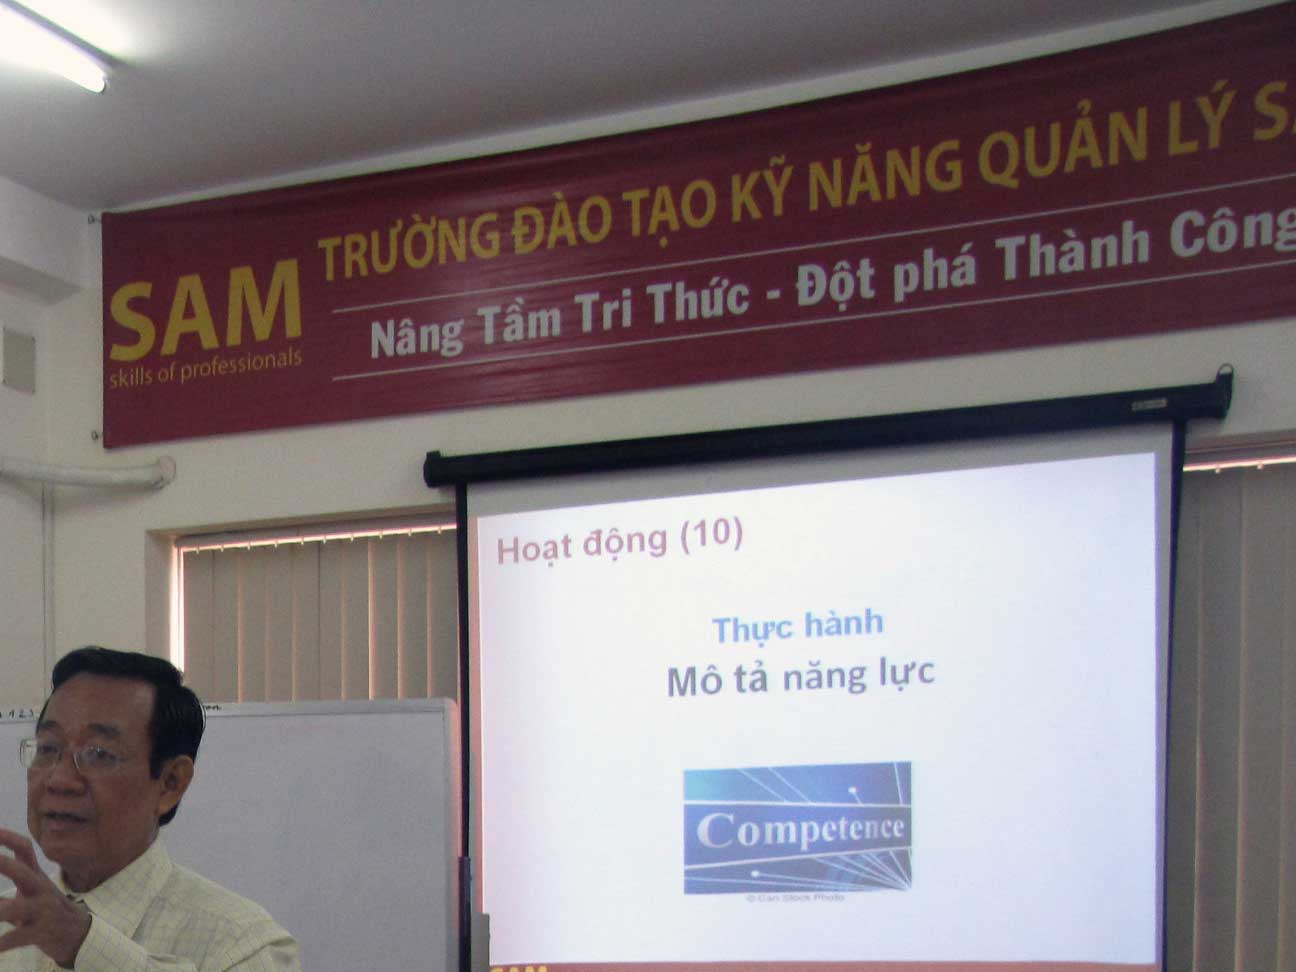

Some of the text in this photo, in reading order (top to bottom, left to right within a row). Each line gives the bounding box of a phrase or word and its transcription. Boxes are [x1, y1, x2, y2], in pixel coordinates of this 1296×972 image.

[318, 79, 1296, 281] TRƯỜNG ĐÀO TẠO KỸ NĂNG QUẢN LÝ S
[371, 318, 463, 358] Nâng
[477, 297, 561, 344] Tầm
[575, 288, 632, 333] Tri
[646, 276, 749, 324] Thức
[796, 260, 875, 311] Đột
[894, 242, 976, 302] phá
[995, 220, 1150, 280] Thành
[1170, 207, 1296, 257] Công
[110, 258, 302, 362] SAM
[109, 347, 303, 389] skills of professionals
[497, 516, 743, 567] Hoạt động (10)
[712, 608, 883, 648] Thực hành
[667, 656, 936, 697] Mô tả năng lực
[697, 812, 905, 852] Competence
